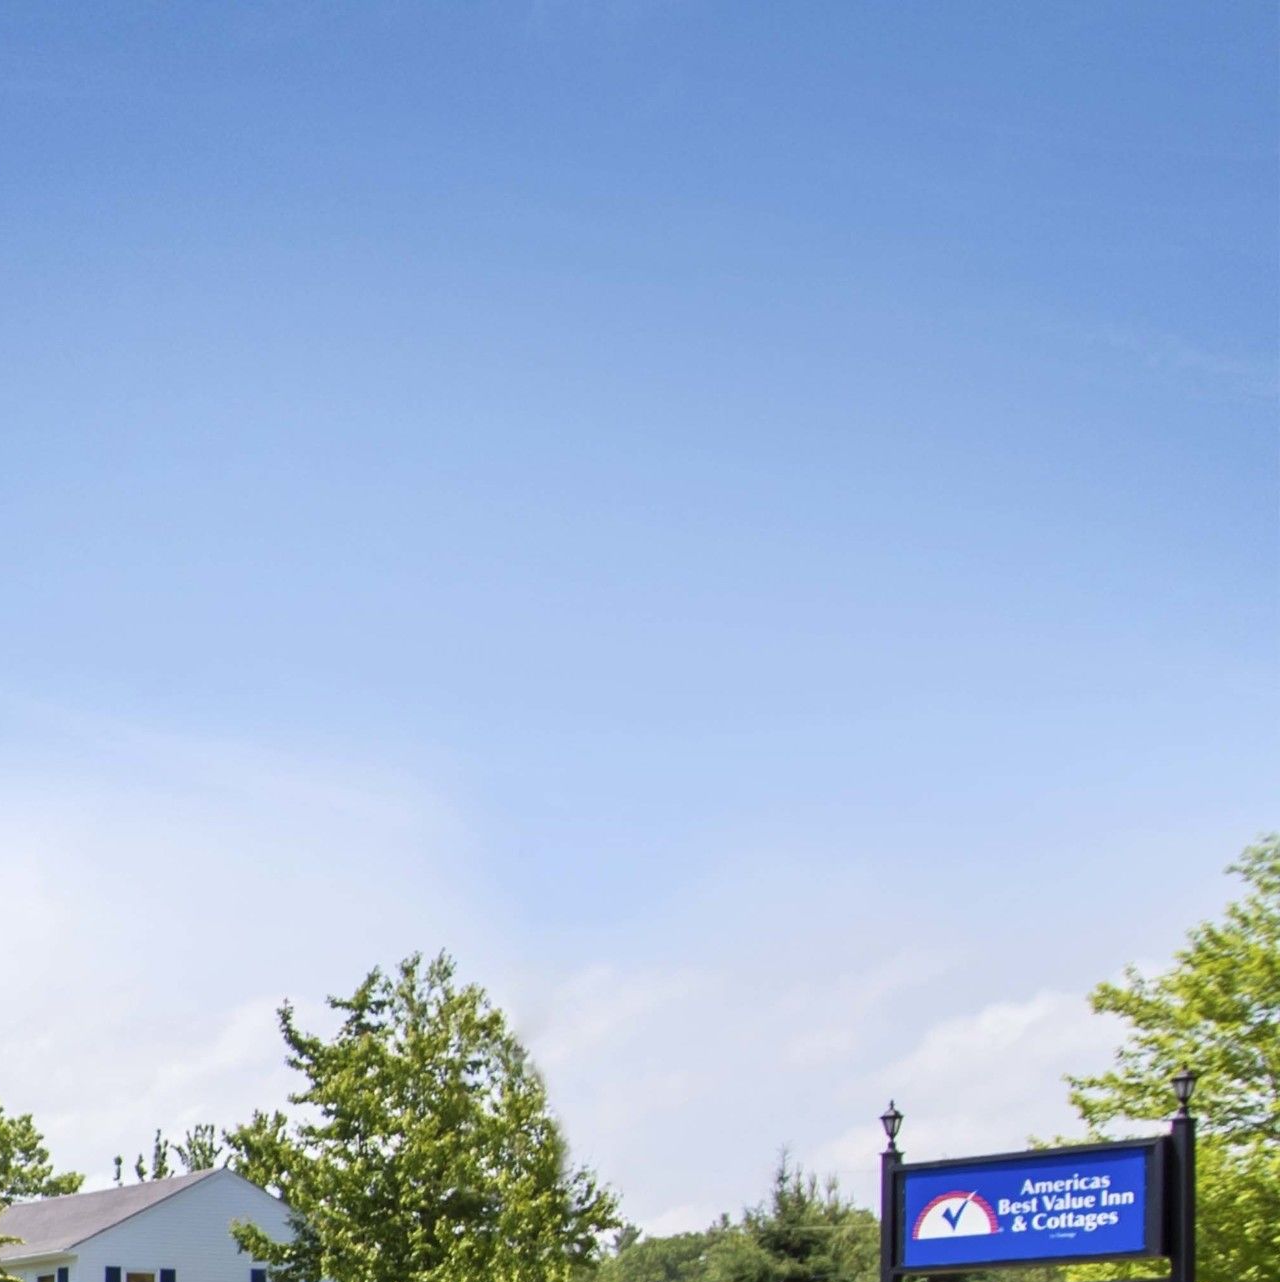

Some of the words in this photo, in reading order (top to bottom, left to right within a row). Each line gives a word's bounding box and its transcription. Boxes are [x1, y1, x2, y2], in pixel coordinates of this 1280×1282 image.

[1021, 1173, 1110, 1195] Americas
[998, 1198, 1037, 1215] Best
[1043, 1193, 1095, 1211] Value
[1101, 1190, 1134, 1206] Inn
[1012, 1215, 1027, 1232] &
[1032, 1211, 1118, 1232] Cottages
